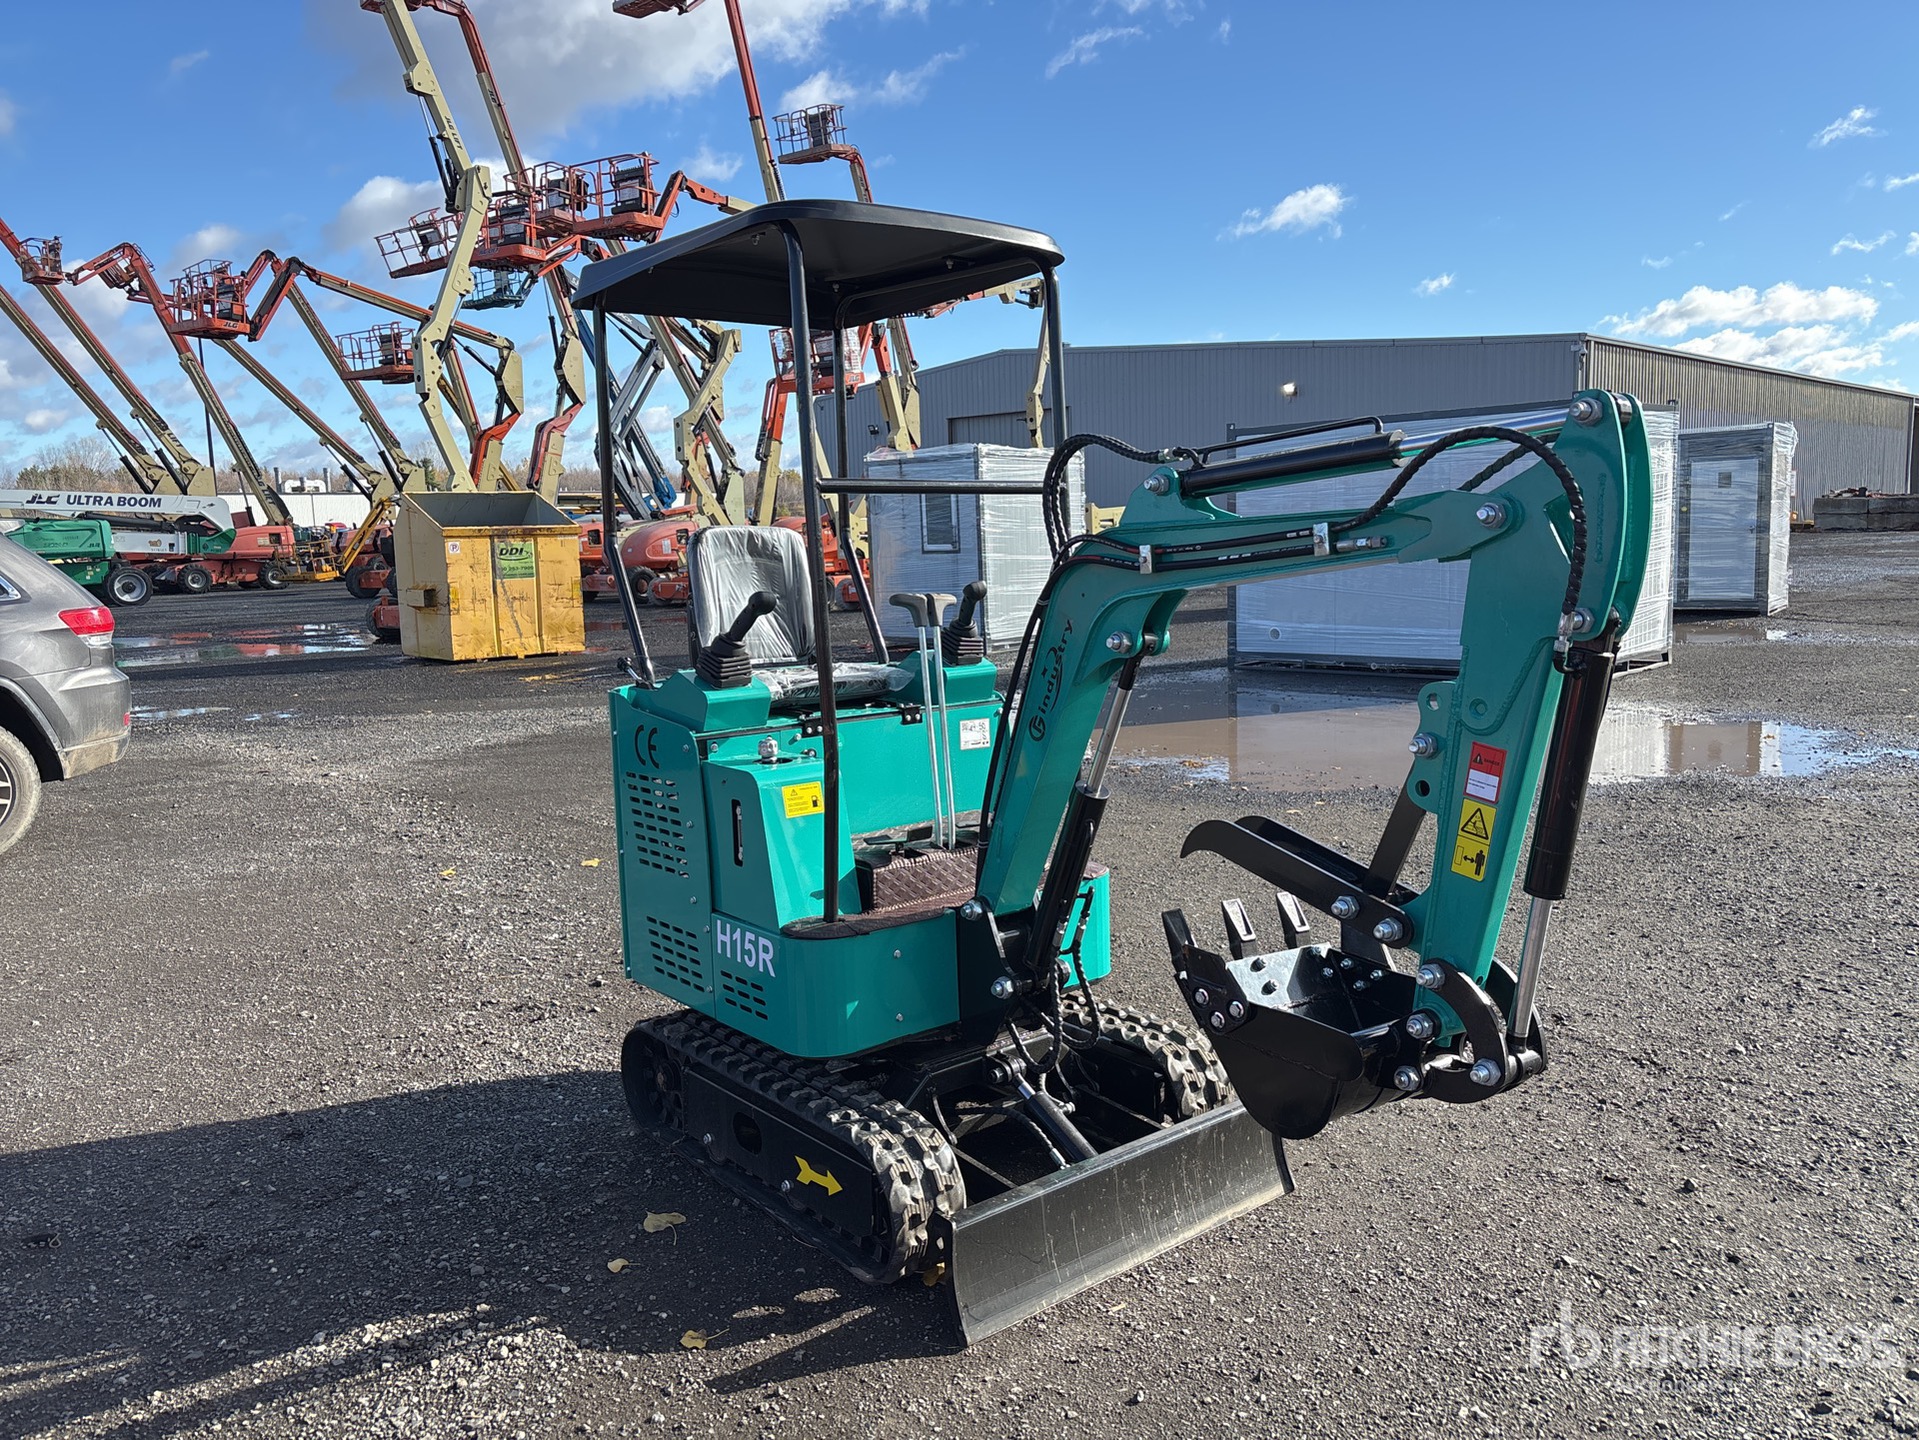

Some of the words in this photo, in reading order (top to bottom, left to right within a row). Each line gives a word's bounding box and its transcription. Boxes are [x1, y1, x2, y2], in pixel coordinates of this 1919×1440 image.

[444, 115, 455, 131] JLG
[451, 132, 463, 150] LIFT
[25, 493, 60, 504] JLG
[66, 494, 114, 507] ULTRA
[116, 496, 162, 508] BOOM
[499, 547, 524, 556] DDI
[634, 724, 660, 769] CE
[716, 919, 776, 978] H15R
